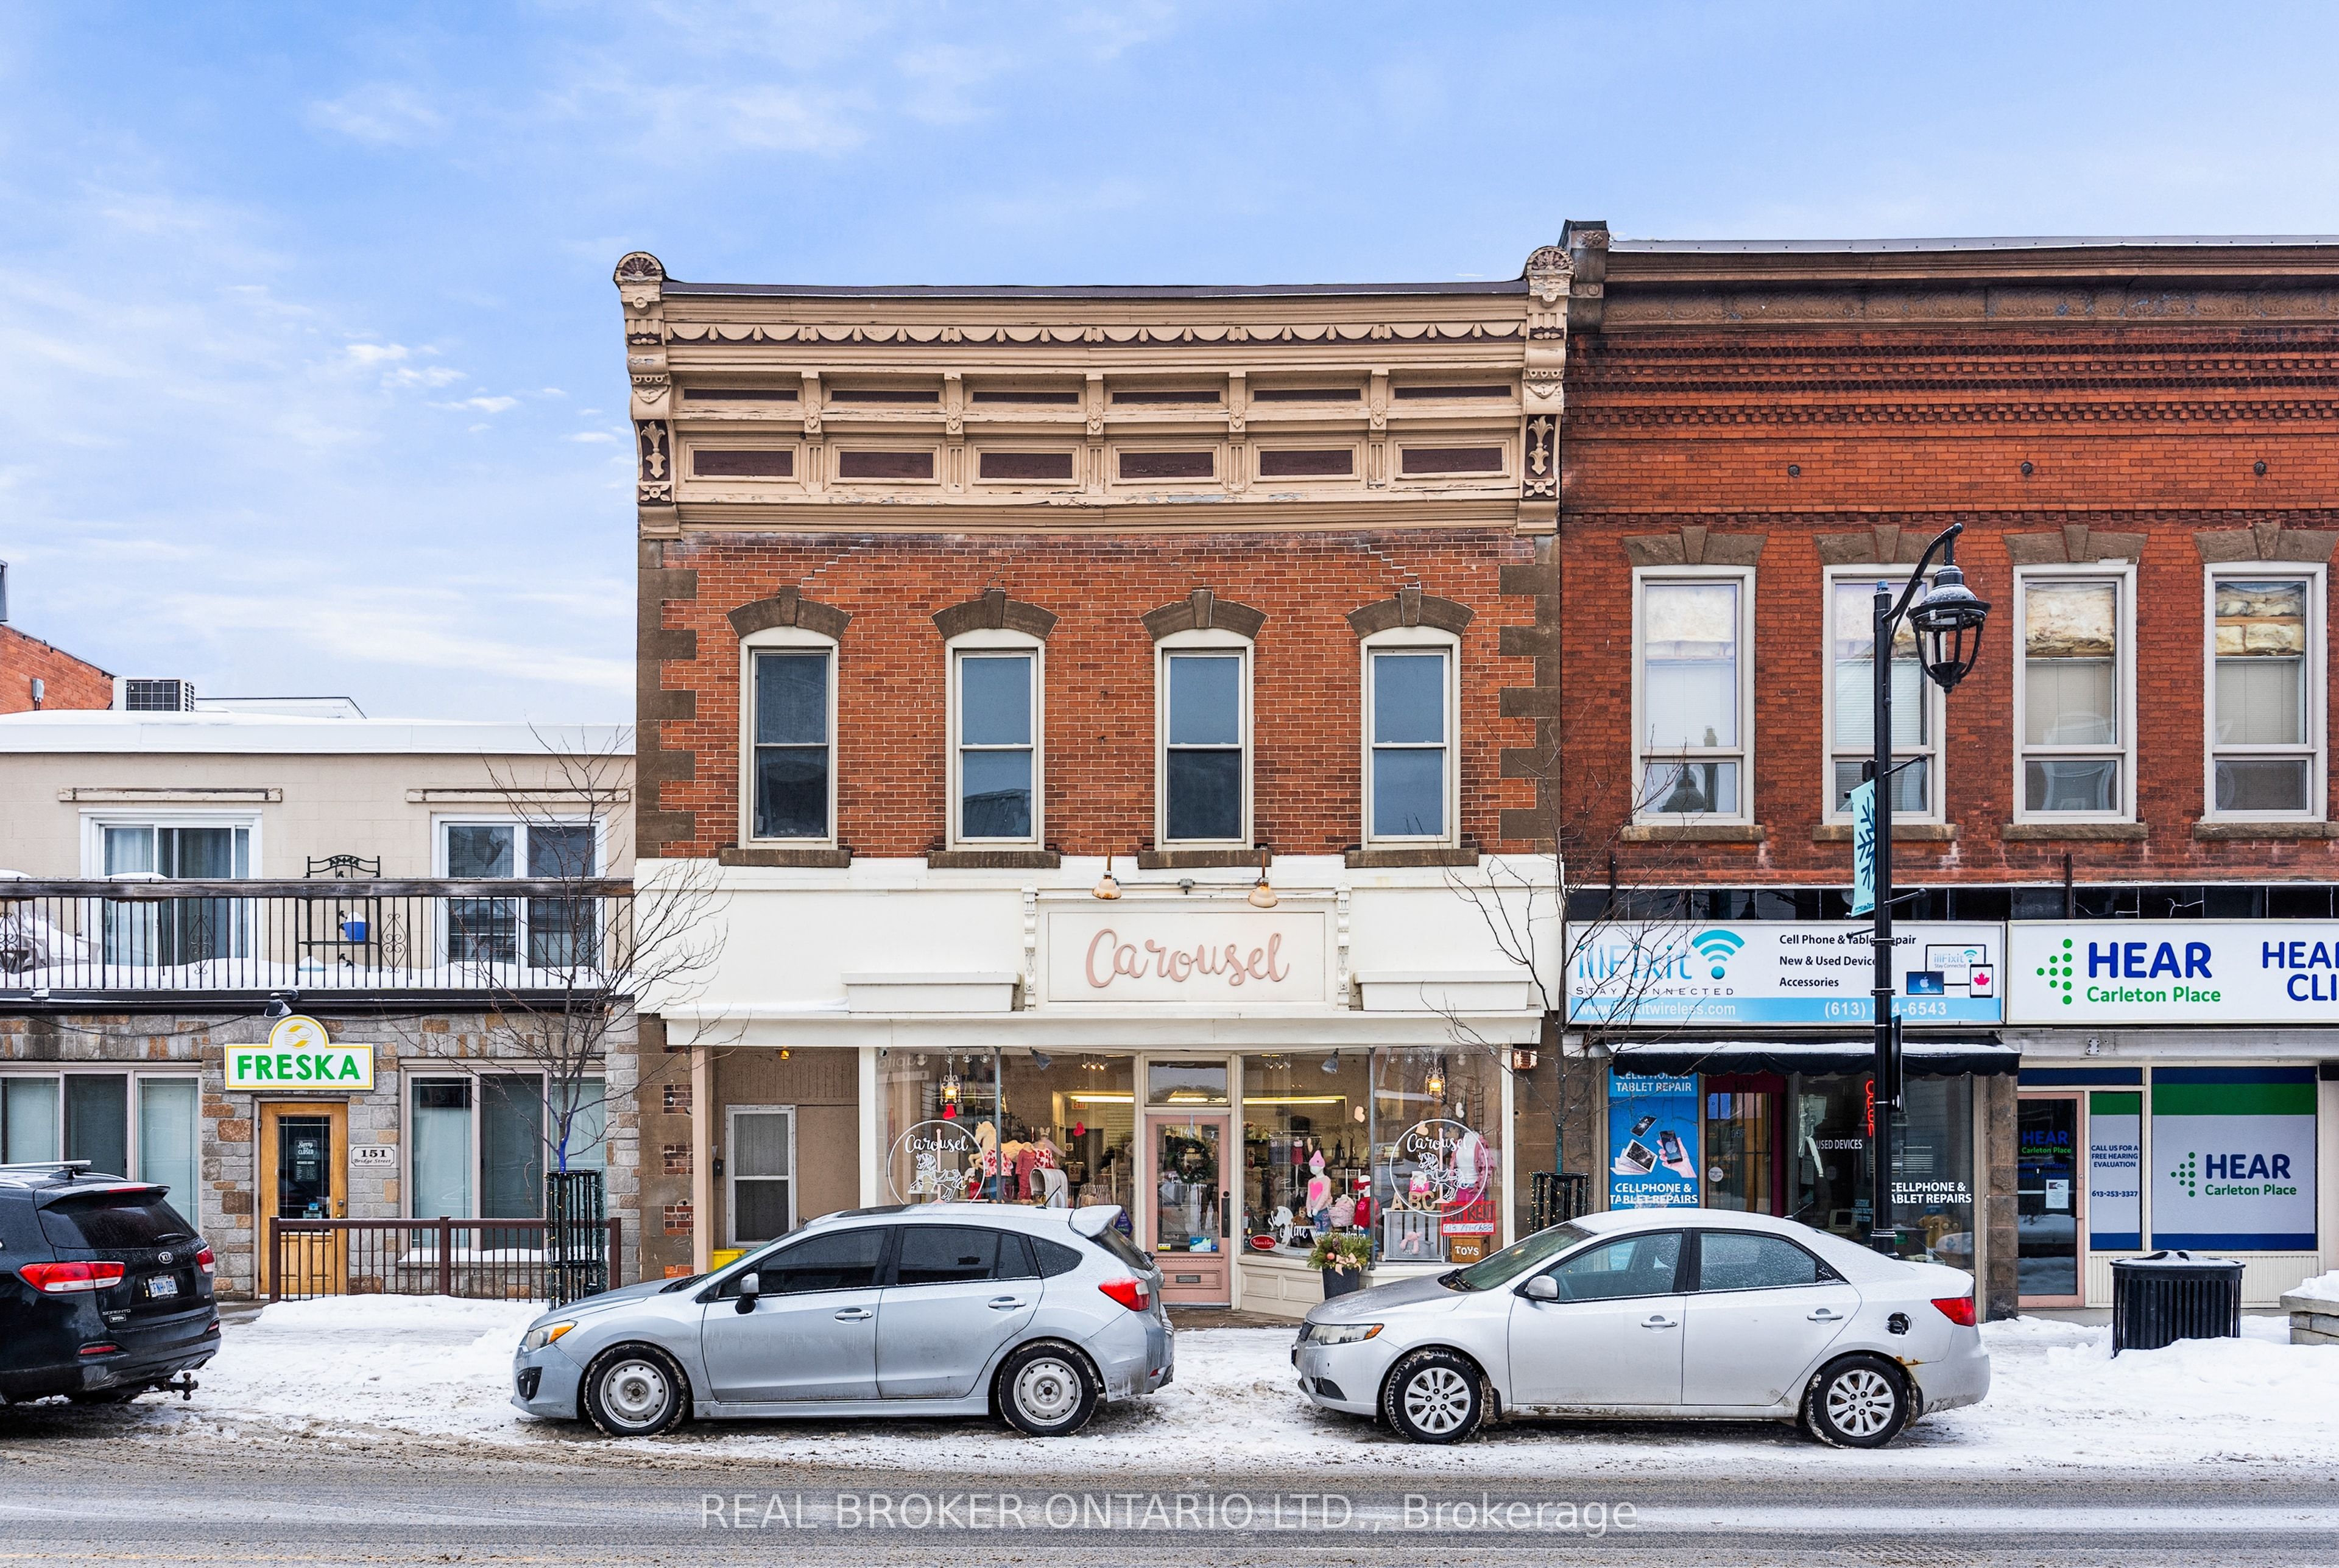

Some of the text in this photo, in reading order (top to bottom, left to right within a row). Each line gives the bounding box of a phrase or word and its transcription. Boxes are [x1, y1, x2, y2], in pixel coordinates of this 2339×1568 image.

[1780, 934, 1916, 946] Cell Phone & Tabl pair
[1085, 929, 1289, 988] Carousel
[2088, 941, 2212, 979] HEAR
[2262, 941, 2339, 969] HEA
[1780, 956, 1875, 966] New & Used Devic
[1780, 977, 1840, 987] Accessories
[1576, 986, 1617, 996] STAY
[2287, 974, 2337, 1002] CLI
[2087, 986, 2221, 1003] Carleton Place
[1824, 1002, 1947, 1019] (613) 4-6543
[237, 1054, 361, 1080] FRESKA
[1615, 1082, 1692, 1092] TABLET REPAIR
[905, 1134, 969, 1153] Carousel
[1406, 1133, 1468, 1153] Carousel
[2022, 1131, 2069, 1145] HEAR
[1816, 1139, 1863, 1150] USED DEVICES
[2206, 1154, 2291, 1180] HEAR
[1615, 1183, 1692, 1193] CELLPHONE &
[1957, 1182, 1966, 1192] &
[2205, 1184, 2297, 1195] Carleton Place
[1610, 1195, 1650, 1204] TABLET
[1652, 1195, 1698, 1204] REPAIRS
[1891, 1194, 1972, 1204] ABLET REPAIRS
[1455, 1245, 1480, 1256] TOYS
[161, 1253, 172, 1262] KIA
